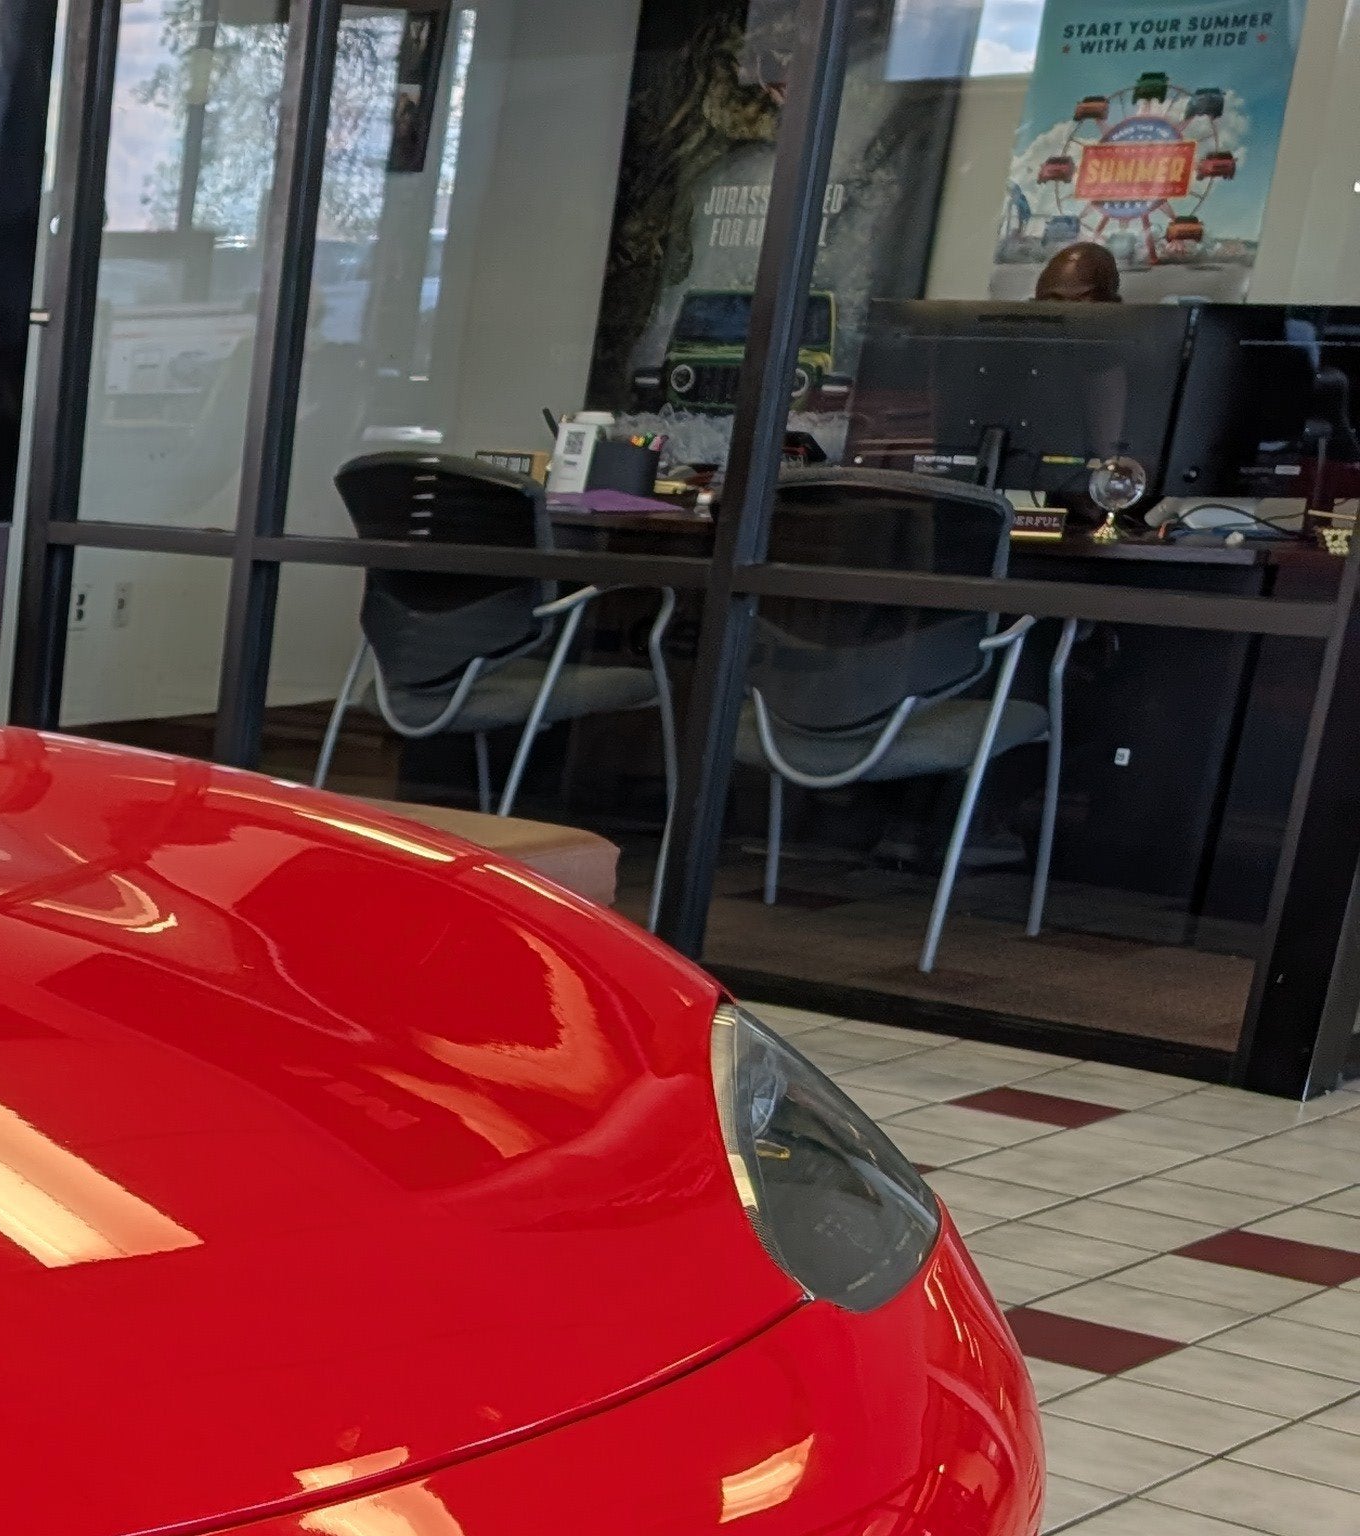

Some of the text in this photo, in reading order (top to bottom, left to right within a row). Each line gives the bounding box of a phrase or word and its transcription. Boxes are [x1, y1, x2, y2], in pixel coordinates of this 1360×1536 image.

[1062, 12, 1274, 40] START YOUR SUMMER
[1079, 31, 1249, 54] WITH A NEW RIDE
[1083, 155, 1188, 184] SUMMER
[704, 184, 772, 216] JURASS
[709, 217, 744, 247] FOR
